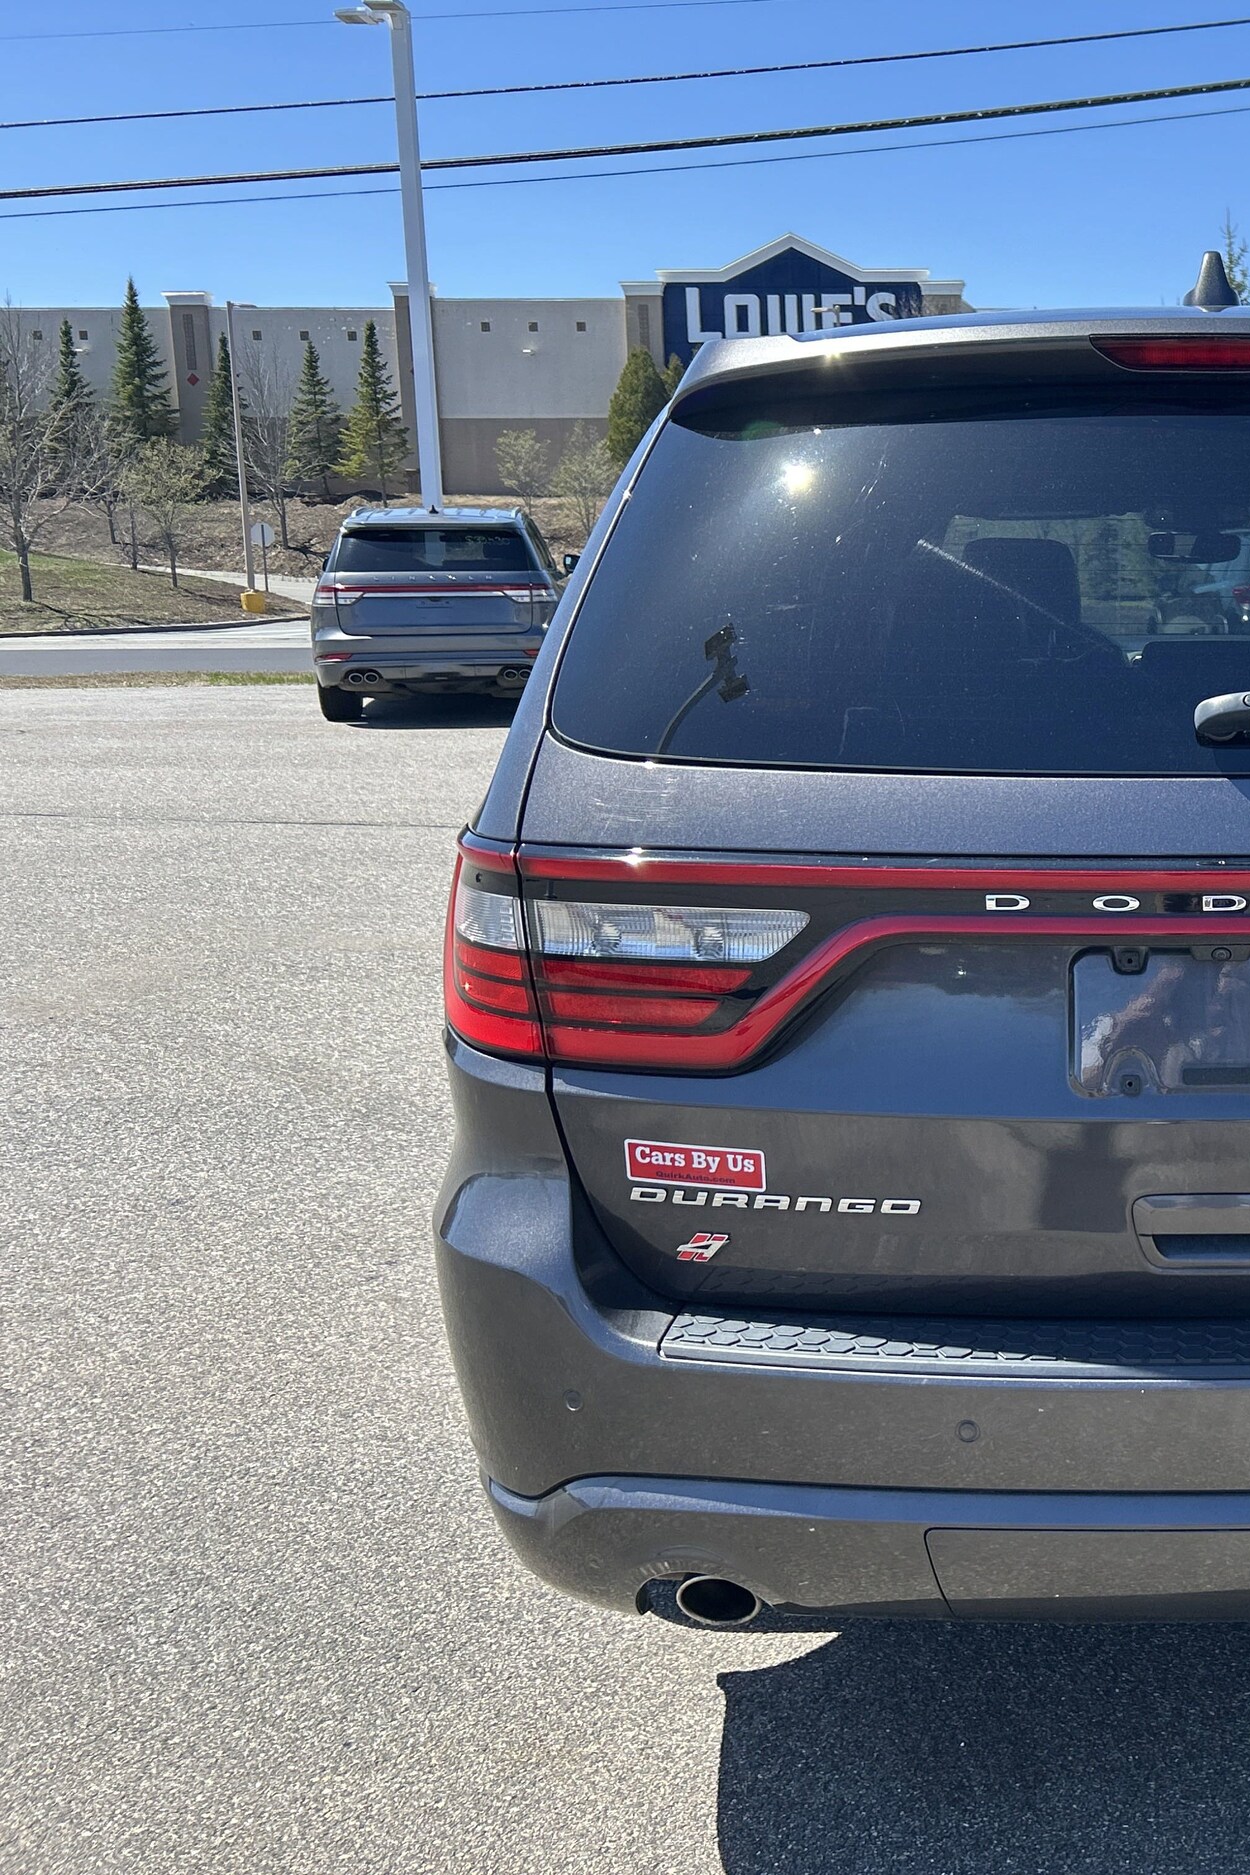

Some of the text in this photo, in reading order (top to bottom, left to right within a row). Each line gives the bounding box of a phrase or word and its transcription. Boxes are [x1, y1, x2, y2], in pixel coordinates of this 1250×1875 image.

[635, 1146, 755, 1173] Cars By Us
[655, 1170, 736, 1184] QuirkAuto.com
[629, 1187, 921, 1214] DURANGO
